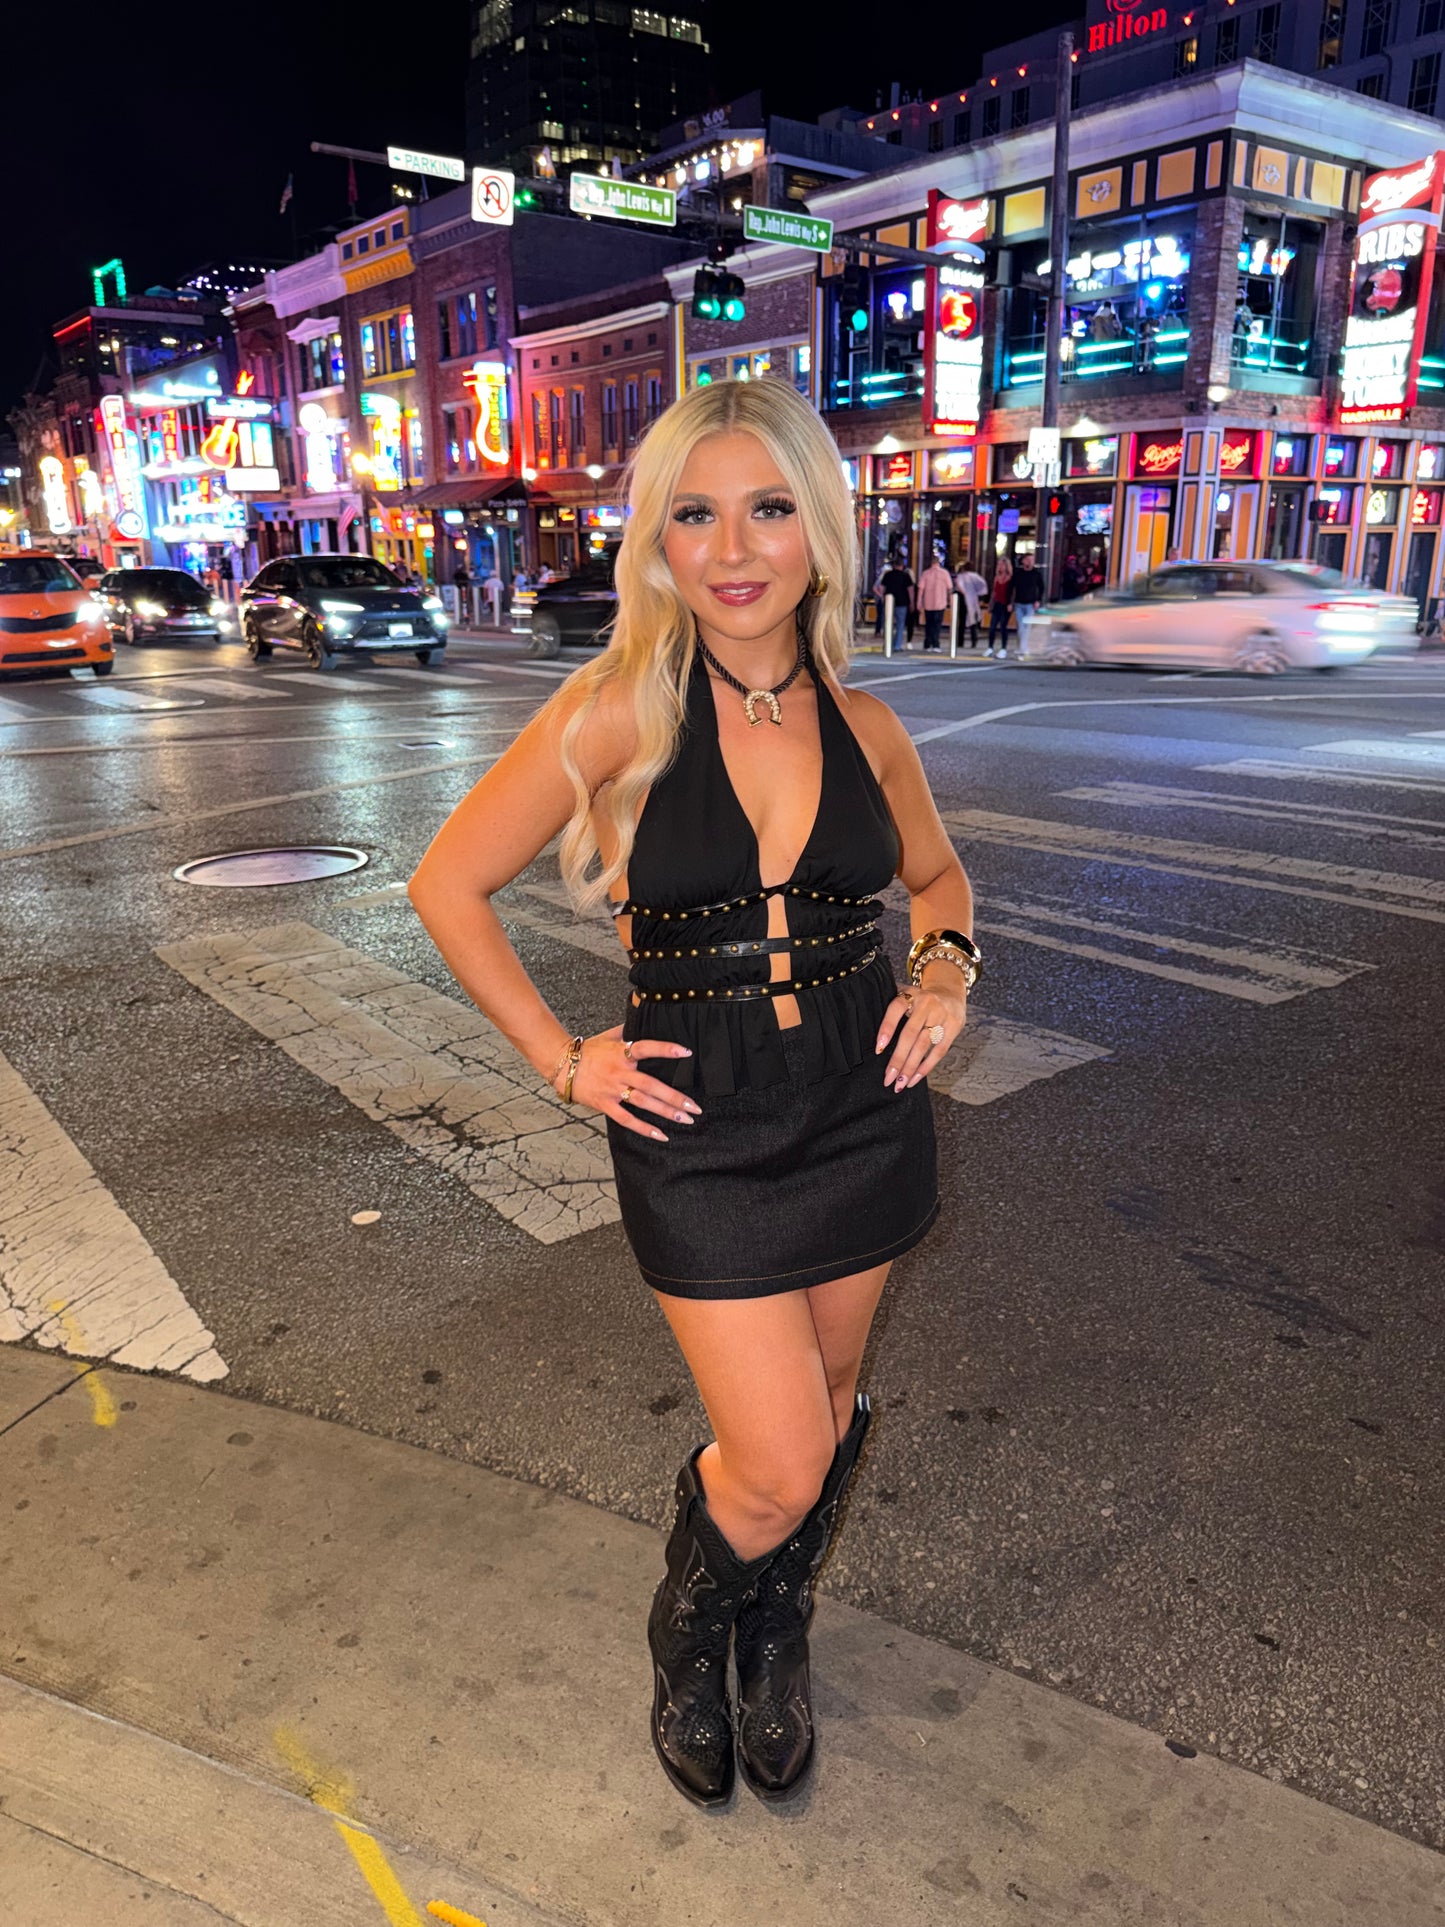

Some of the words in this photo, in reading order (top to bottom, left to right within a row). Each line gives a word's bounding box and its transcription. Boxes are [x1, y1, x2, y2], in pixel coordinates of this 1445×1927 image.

[1088, 8, 1167, 53] Hilton
[404, 153, 461, 179] PARKING
[606, 186, 626, 208] John
[627, 189, 650, 212] Lewis
[664, 197, 671, 217] N
[763, 214, 781, 235] John
[781, 217, 801, 239] Lewis
[811, 224, 819, 244] S
[1358, 223, 1424, 265] RIBS
[1341, 408, 1402, 424] NASHVILLE
